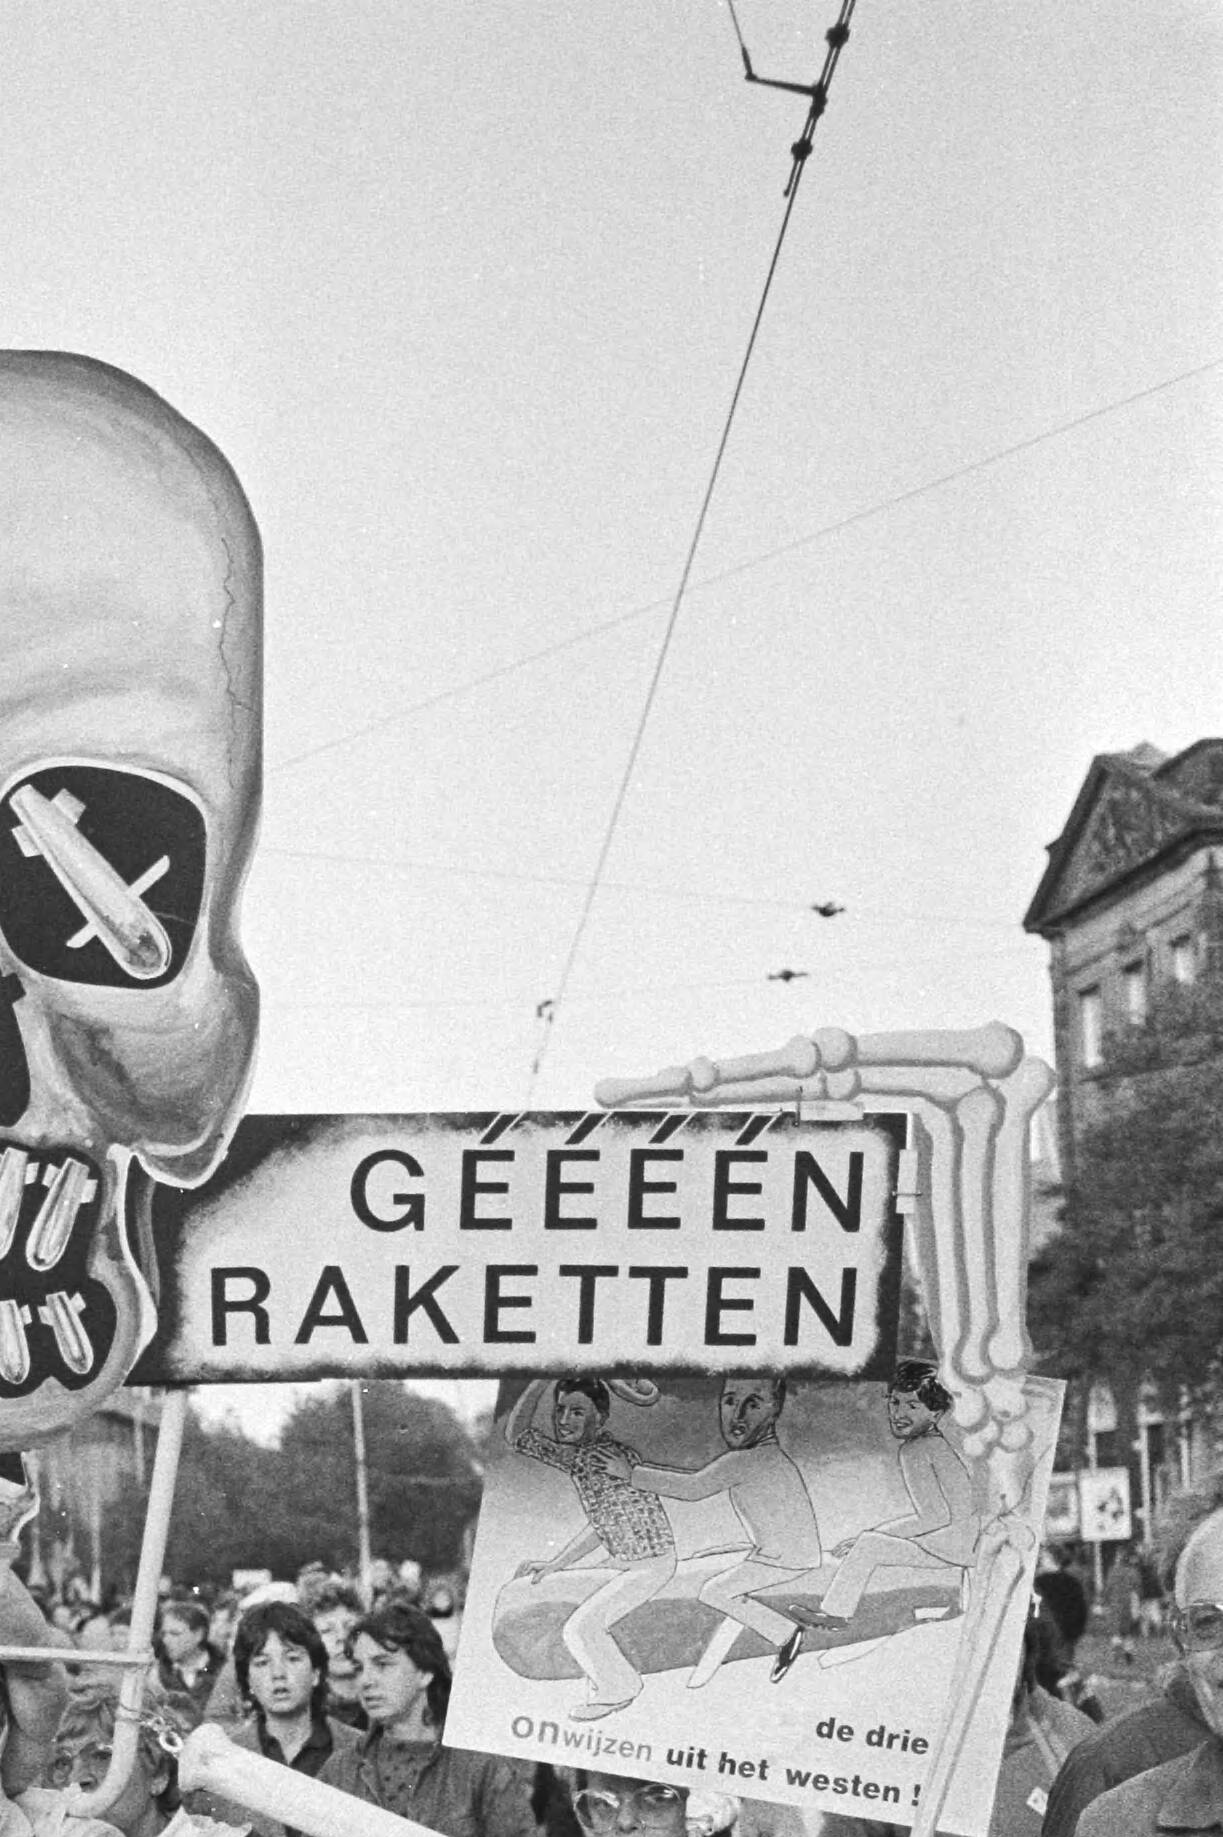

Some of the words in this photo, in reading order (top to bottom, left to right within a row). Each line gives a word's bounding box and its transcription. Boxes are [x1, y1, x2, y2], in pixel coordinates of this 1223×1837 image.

[349, 1114, 865, 1234] GÉÉÉÉN
[210, 1263, 858, 1348] RAKETTEN
[510, 1713, 652, 1764] onwijzen
[665, 1745, 709, 1771] uit
[717, 1750, 770, 1782] het
[784, 1767, 901, 1805] westen
[815, 1716, 855, 1743] de
[865, 1724, 930, 1756] drie
